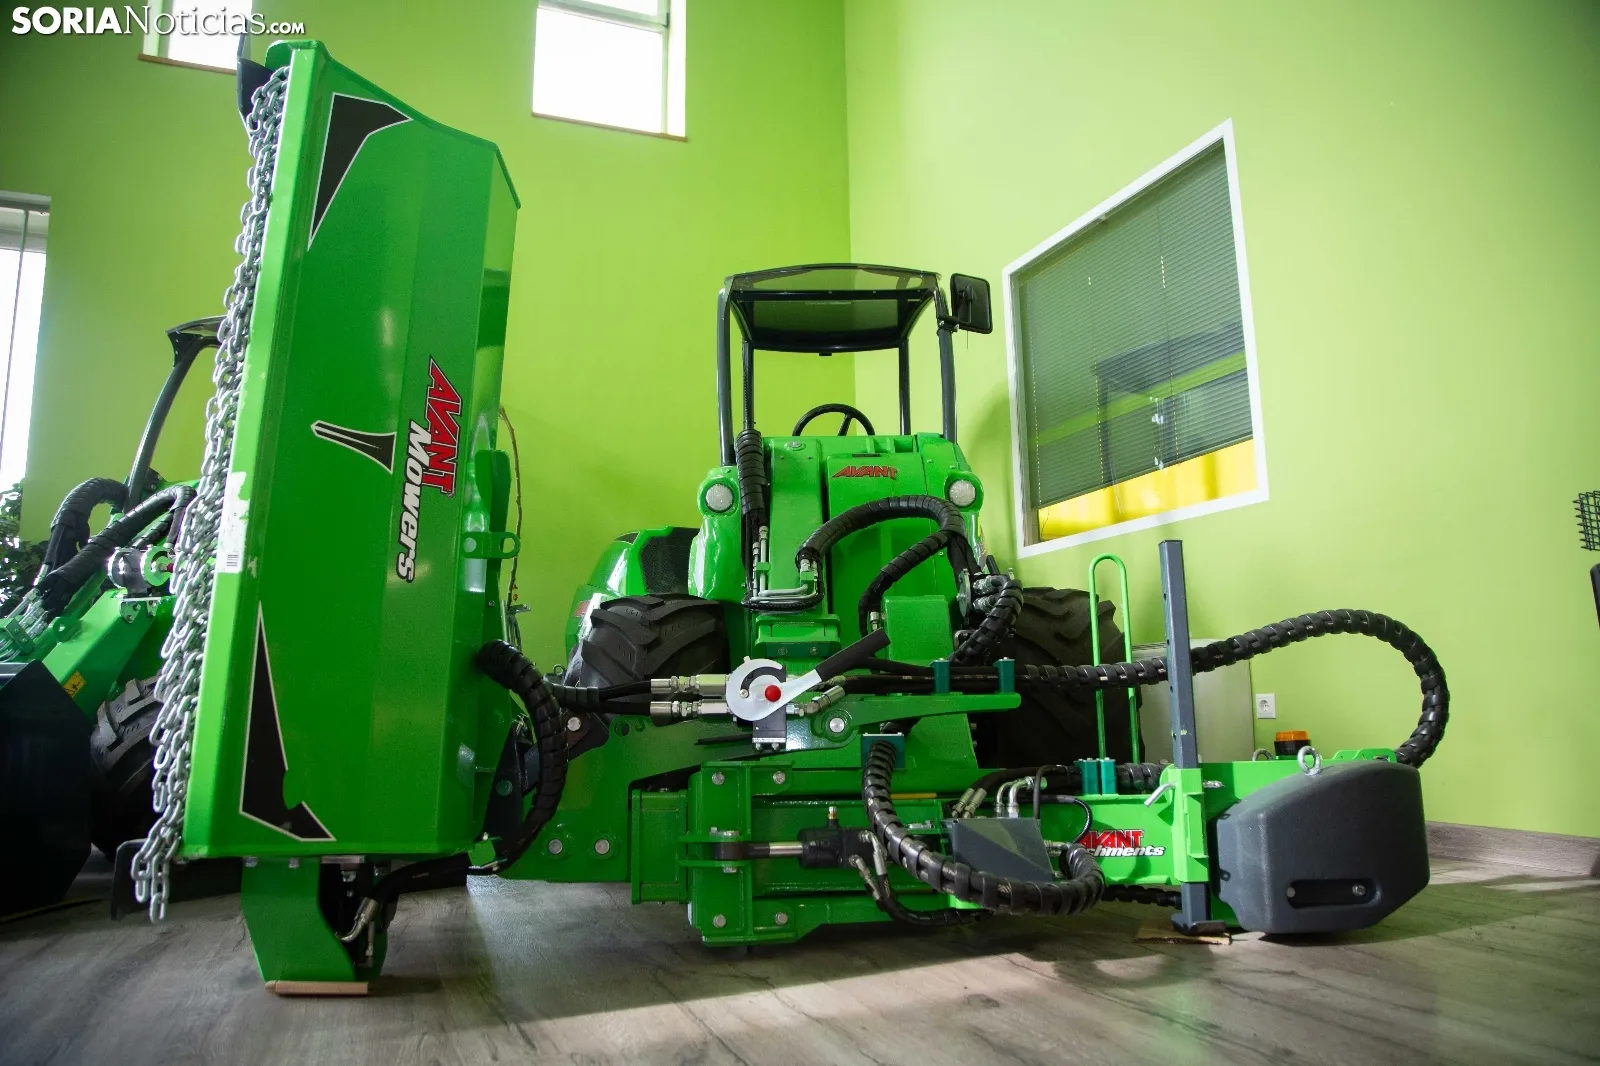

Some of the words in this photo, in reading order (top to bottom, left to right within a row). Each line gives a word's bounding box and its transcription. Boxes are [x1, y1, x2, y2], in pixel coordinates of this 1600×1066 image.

[422, 354, 462, 494] AVANT
[396, 420, 432, 583] Mowers
[831, 465, 898, 480] AVANT
[1088, 845, 1166, 857] chments
